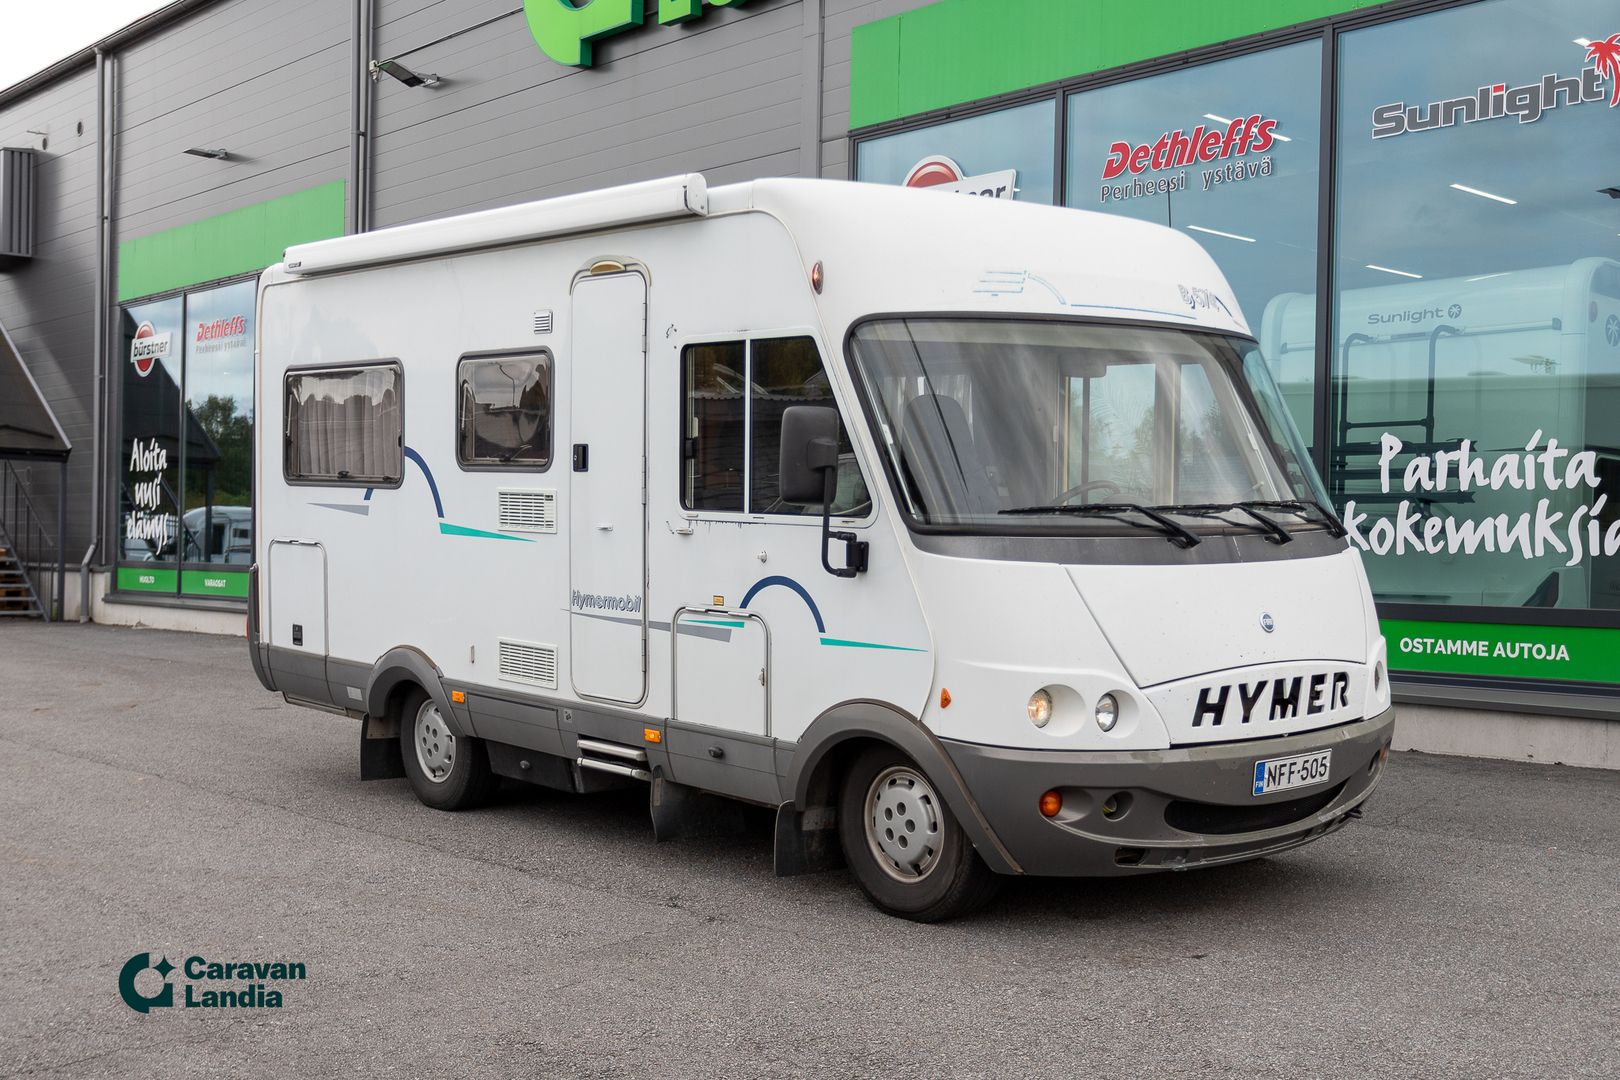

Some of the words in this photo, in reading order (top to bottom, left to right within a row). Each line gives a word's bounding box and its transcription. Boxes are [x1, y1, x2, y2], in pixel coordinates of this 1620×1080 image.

[1371, 66, 1605, 140] Sunlight
[1101, 114, 1279, 180] Dethleffs
[1100, 171, 1186, 204] Perheesi
[1202, 156, 1273, 191] ystävä
[196, 314, 246, 342] Dethleffs
[1367, 307, 1444, 325] Sunlight
[133, 338, 169, 357] bürstner
[129, 437, 168, 473] Aloita
[1378, 429, 1602, 494] Parhaita
[572, 589, 642, 613] Hymermobil
[1399, 637, 1489, 658] OSTAMME
[1493, 641, 1570, 661] AUTOJA
[1192, 671, 1350, 728] HYMER
[1266, 756, 1328, 788] NFF-505
